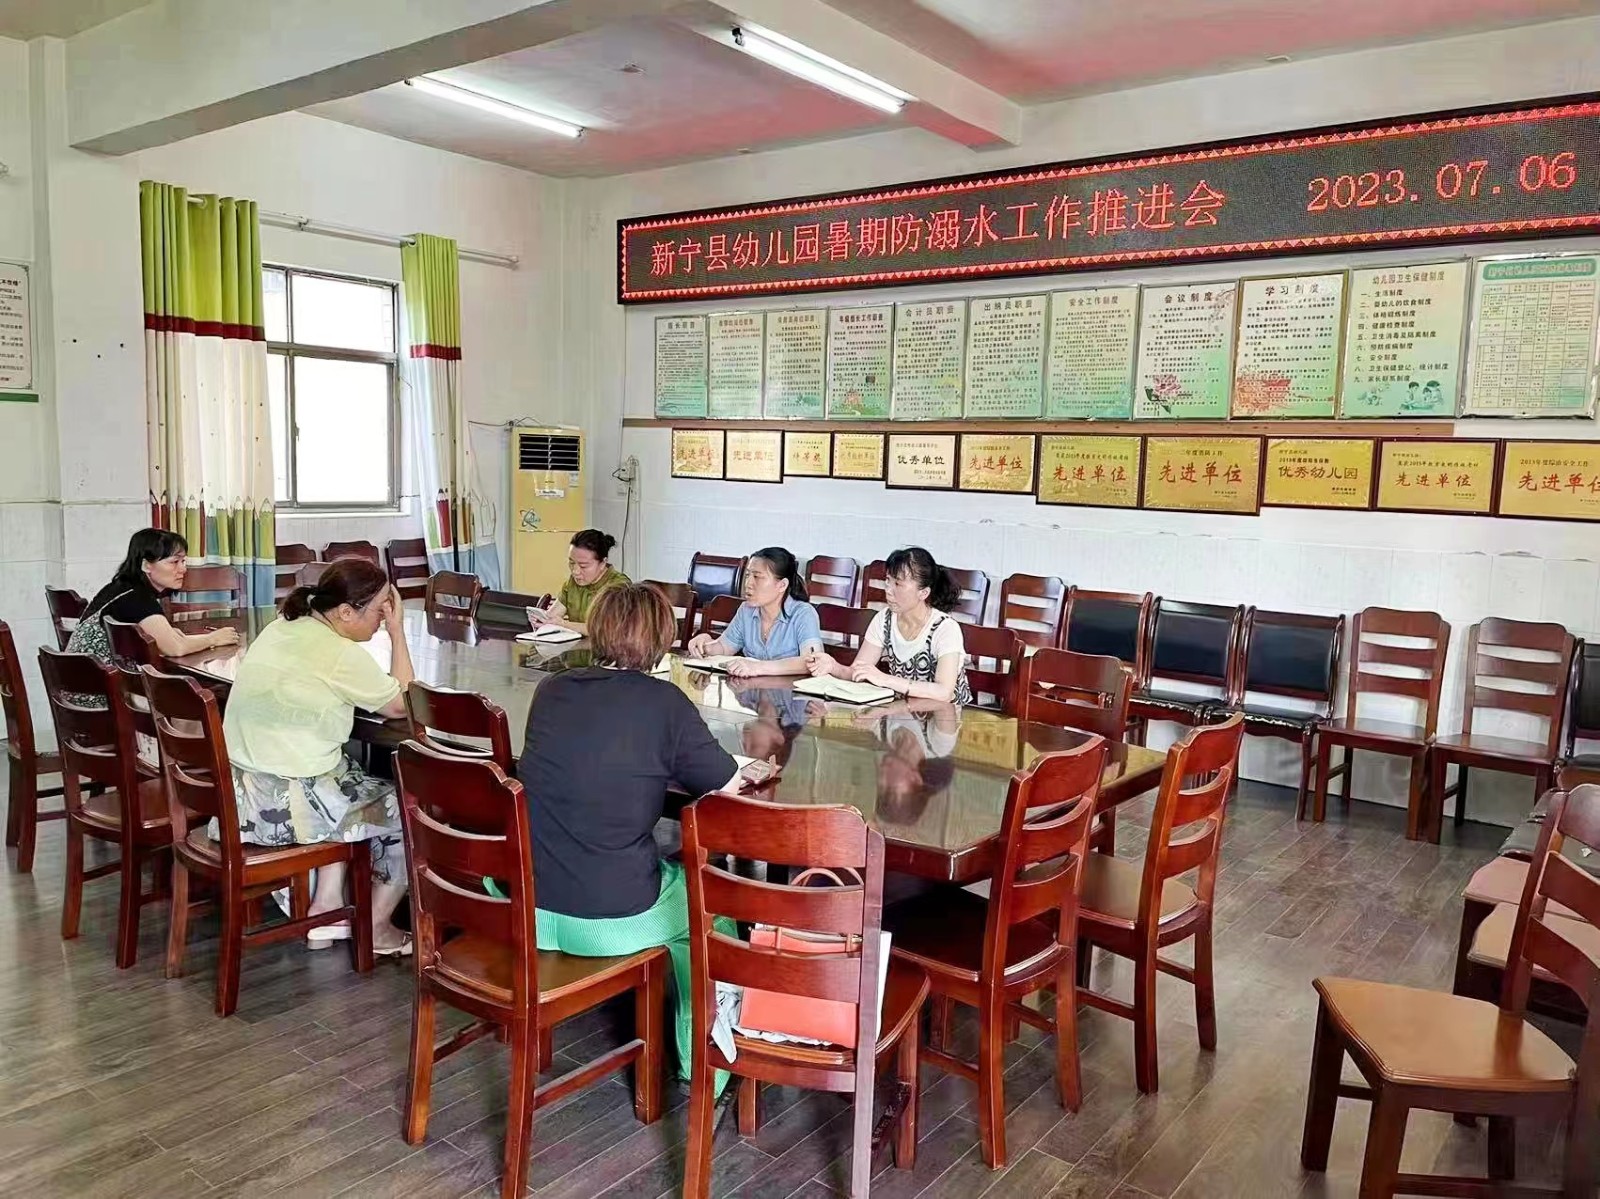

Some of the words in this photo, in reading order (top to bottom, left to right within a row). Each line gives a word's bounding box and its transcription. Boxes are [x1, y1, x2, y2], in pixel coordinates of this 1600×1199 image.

[650, 180, 1225, 276] 新宁县幼儿园暑期防溺水工作推进会
[1372, 271, 1445, 284] 幼儿园卫生保健制度
[1265, 283, 1320, 297] 学习制度
[1068, 295, 1118, 306] 安全工作制度
[1164, 291, 1213, 304] 会议制度
[905, 305, 954, 317] 会计员职责
[984, 300, 1033, 311] 出纳员职责
[897, 455, 945, 465] 优秀单位
[969, 454, 1023, 471] 先进单位
[1053, 463, 1127, 483] 先进单位
[1158, 460, 1242, 486] 先进单位
[1278, 465, 1358, 479] 优秀幼儿园
[1395, 471, 1472, 488] 先进单位
[1518, 470, 1600, 494] 先进单位
